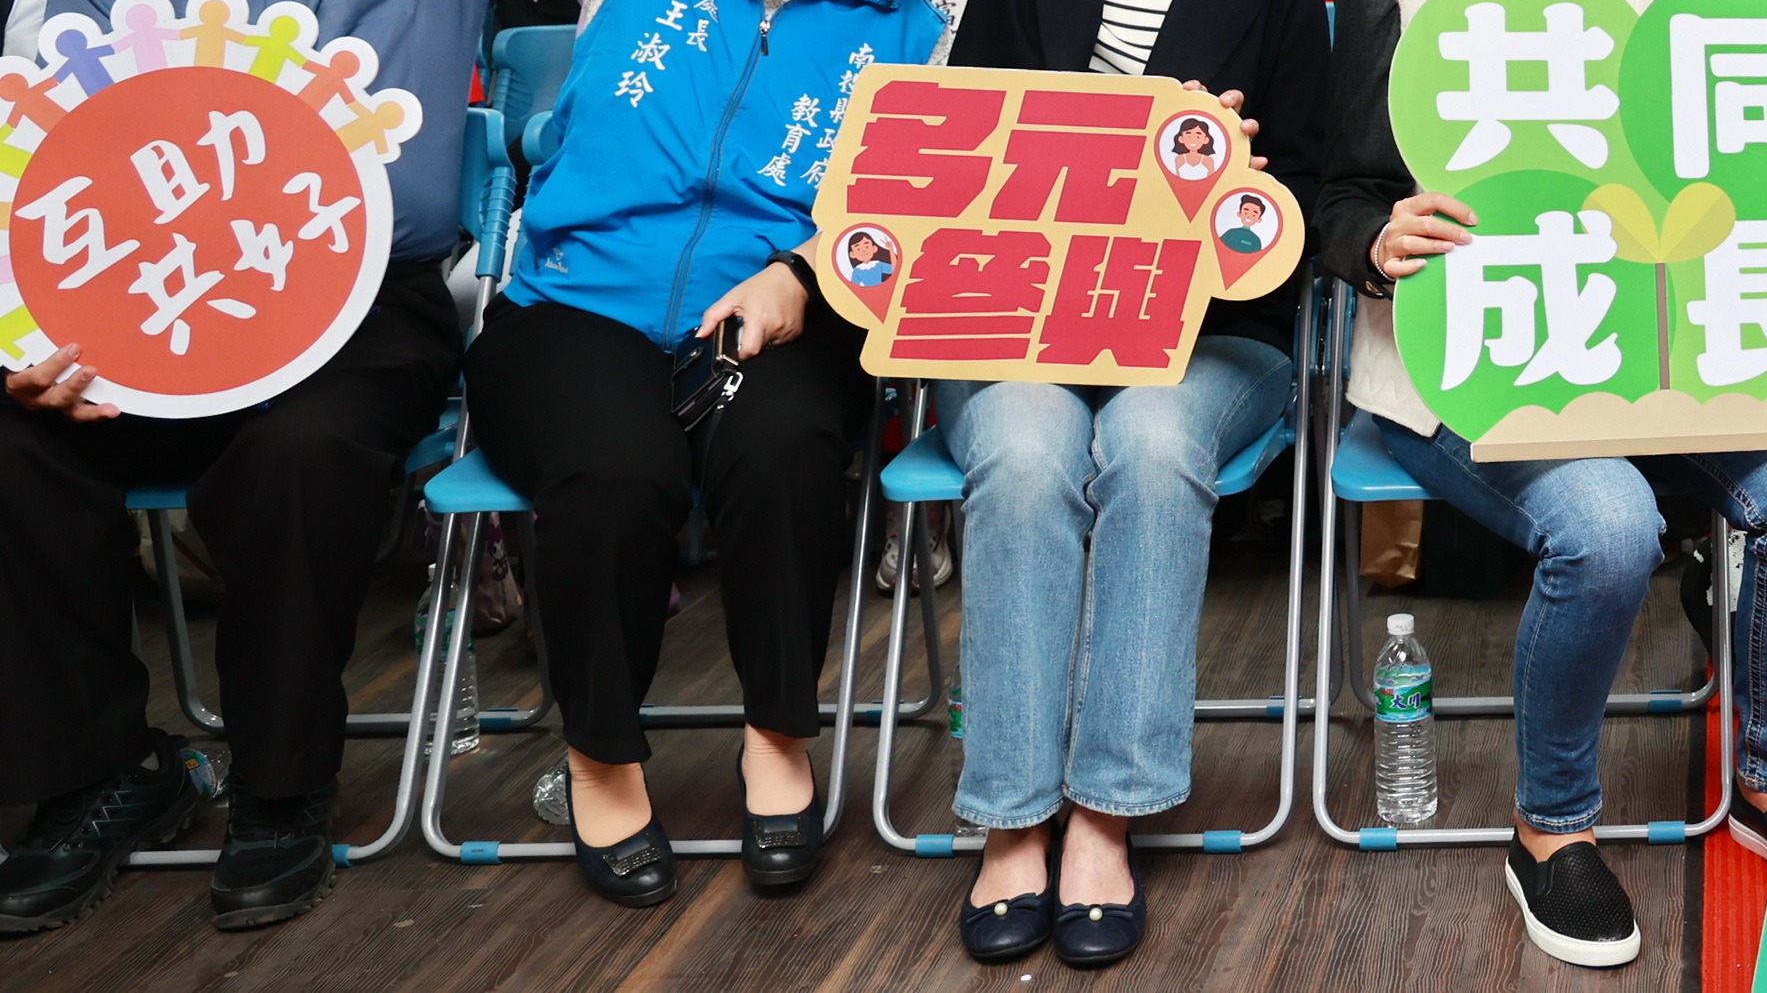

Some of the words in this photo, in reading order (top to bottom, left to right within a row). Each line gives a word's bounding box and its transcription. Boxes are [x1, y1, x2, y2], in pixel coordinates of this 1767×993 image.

[614, 0, 688, 108] 王淑玲
[15, 110, 266, 289] 互助
[757, 93, 821, 187] 教育處
[846, 80, 1155, 226] 多元
[128, 172, 361, 355] 共好
[889, 228, 1203, 369] 參與
